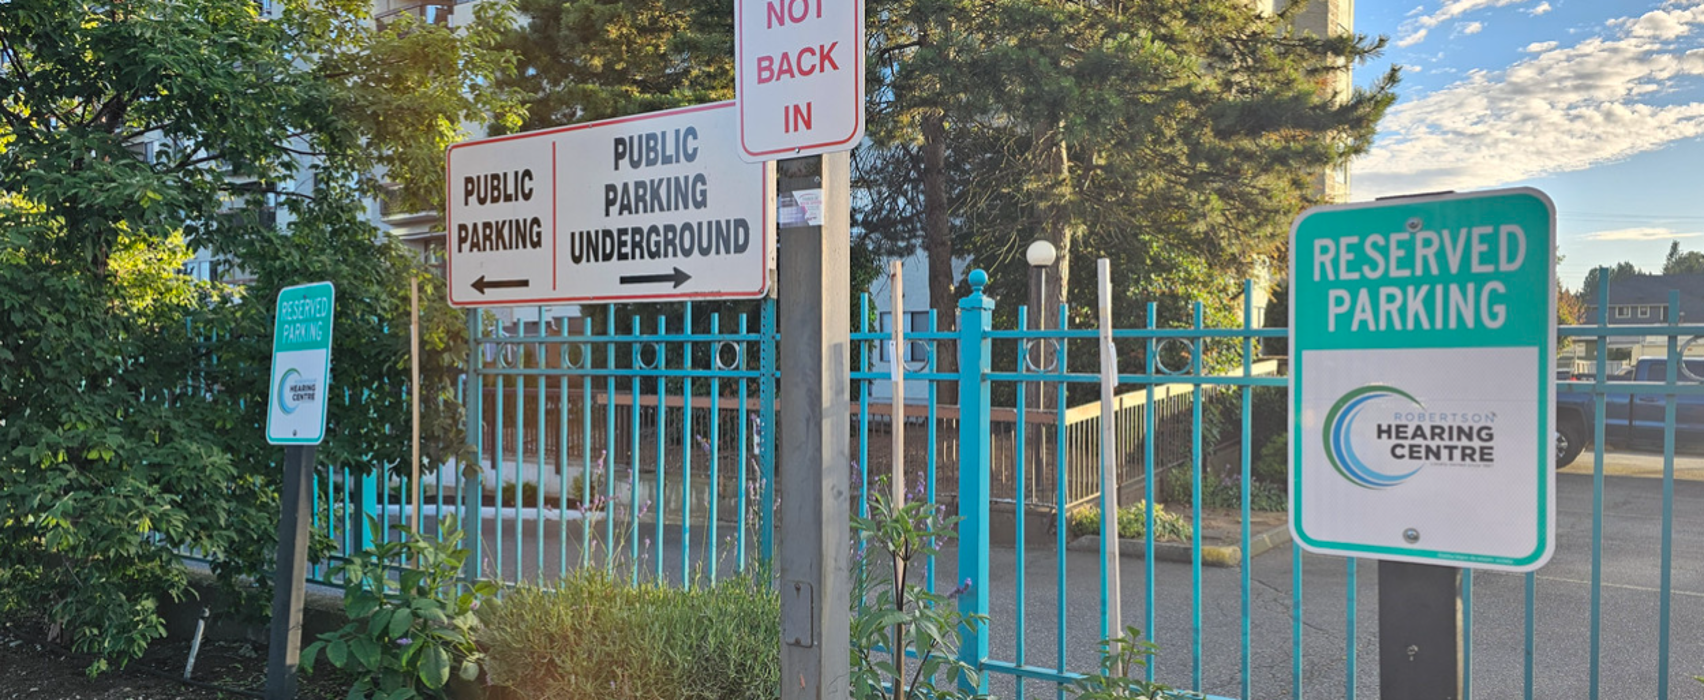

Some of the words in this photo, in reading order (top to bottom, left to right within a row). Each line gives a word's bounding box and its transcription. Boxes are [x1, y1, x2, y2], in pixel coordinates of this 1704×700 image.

[757, 41, 839, 84] BACK
[784, 102, 812, 133] IN
[613, 126, 699, 171] PUBLIC
[464, 169, 534, 206] PUBLIC
[604, 173, 708, 217] PARKING
[457, 216, 542, 254] PARKING
[569, 218, 750, 264] UNDERGROUND
[1313, 224, 1527, 282] RESERVED
[282, 297, 328, 320] RESERVED
[1327, 281, 1507, 332] PARKING
[282, 321, 323, 343] PARKING
[289, 383, 316, 393] HEARING
[292, 392, 315, 401] CENTRE
[1376, 423, 1494, 443] HEARING
[1394, 412, 1495, 424] ROBERTSON
[1390, 443, 1494, 463] CENTRE
